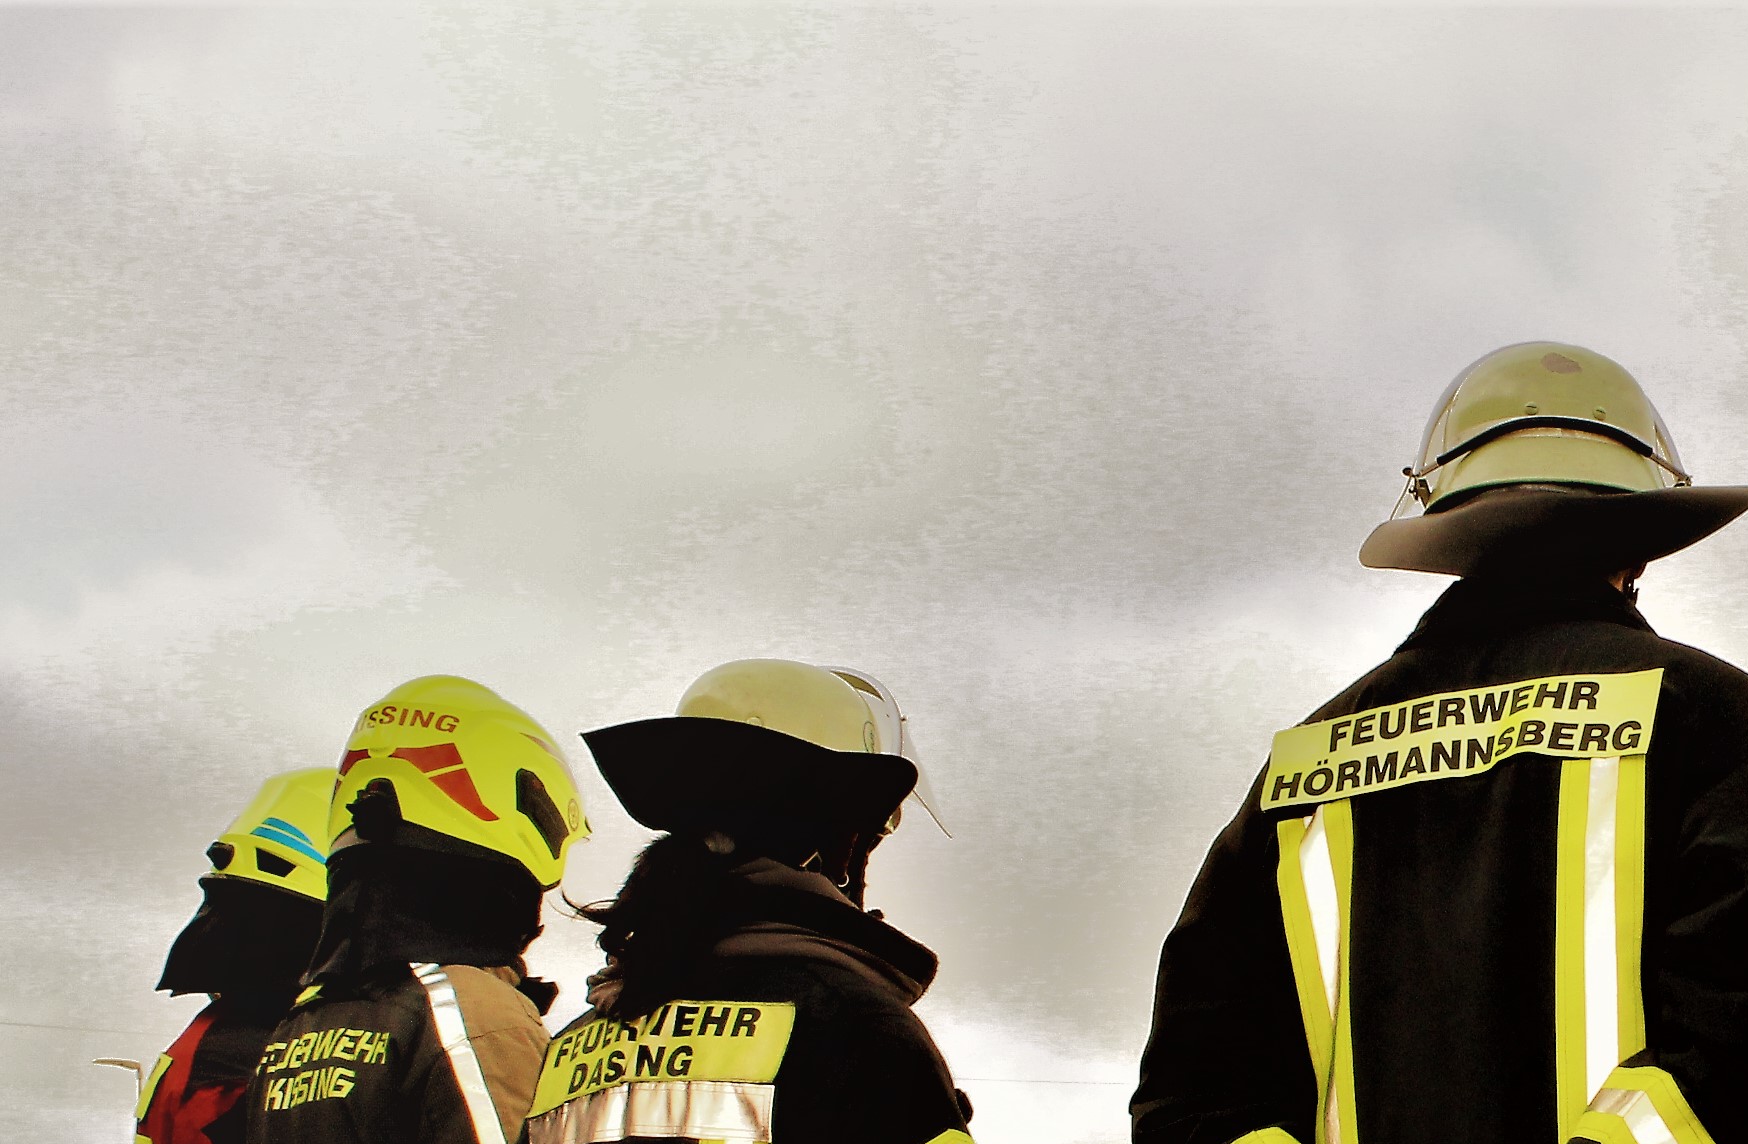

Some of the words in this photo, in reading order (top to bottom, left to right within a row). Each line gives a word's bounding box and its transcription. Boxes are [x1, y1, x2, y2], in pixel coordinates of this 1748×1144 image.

[1328, 680, 1601, 754] FEUERWEHR
[1270, 719, 1643, 802] HÖRMANNSBERG
[567, 1044, 694, 1096] DASNG
